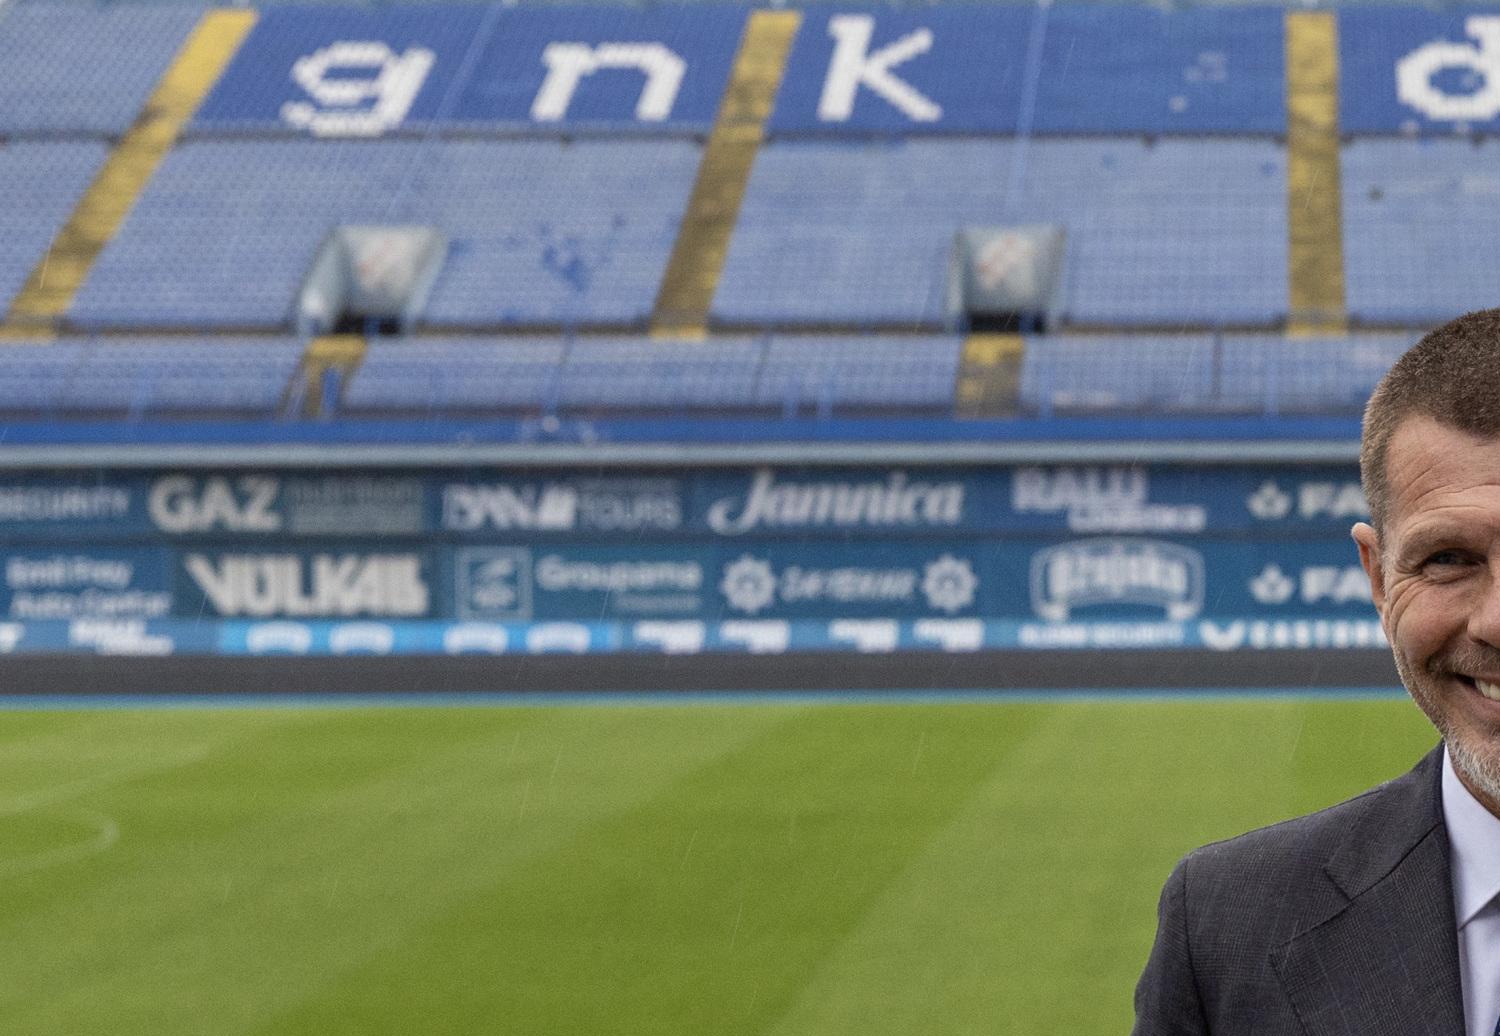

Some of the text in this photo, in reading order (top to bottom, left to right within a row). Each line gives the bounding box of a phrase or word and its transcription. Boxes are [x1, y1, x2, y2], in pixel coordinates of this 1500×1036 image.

[149, 474, 281, 532] GAZ
[708, 468, 966, 535] Jamnica
[537, 555, 703, 591] Groupama
